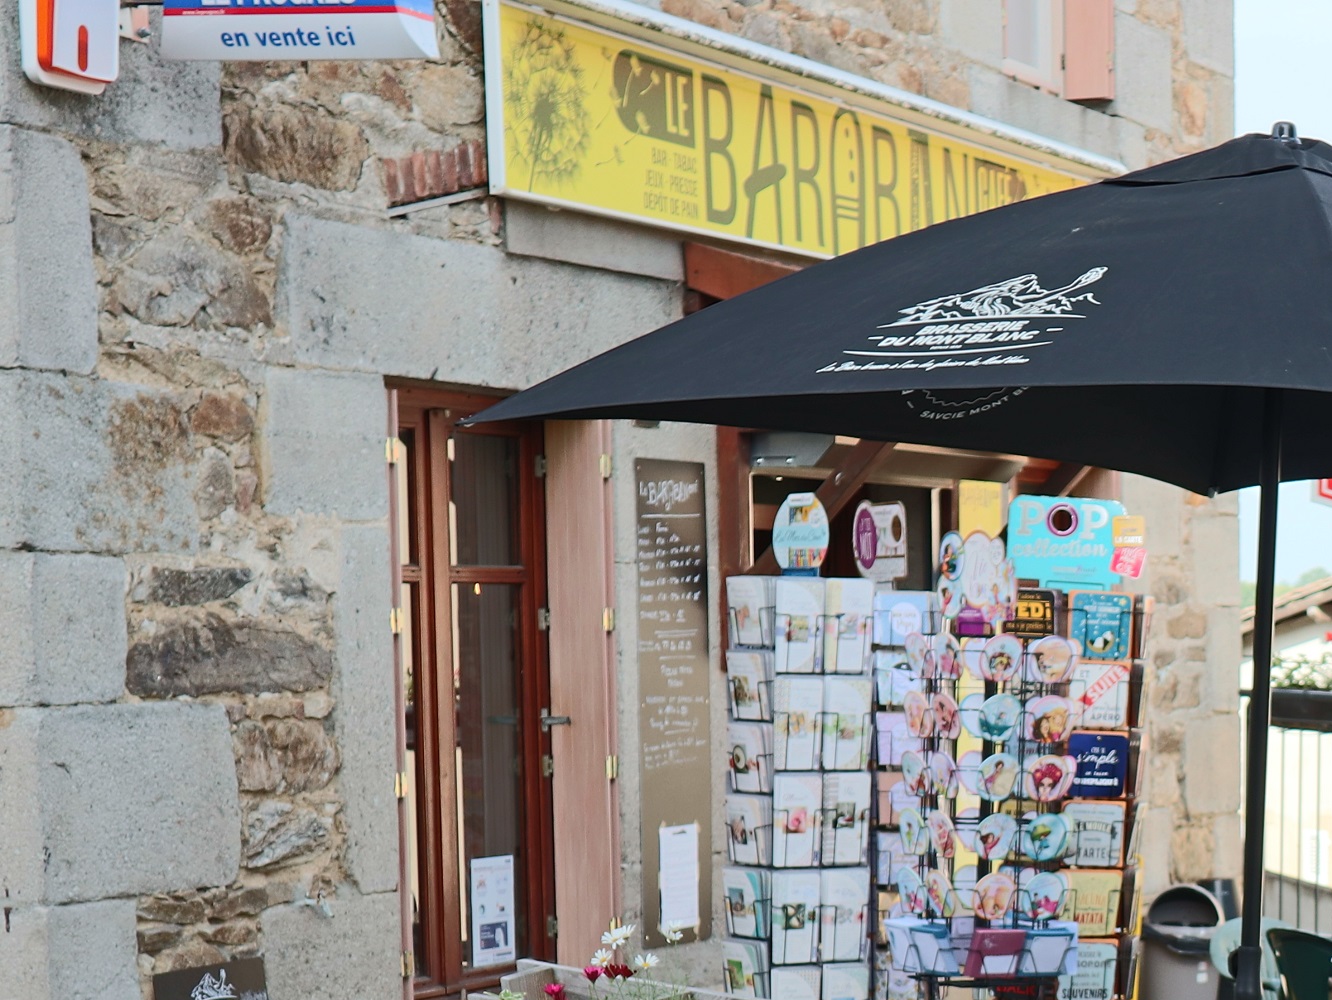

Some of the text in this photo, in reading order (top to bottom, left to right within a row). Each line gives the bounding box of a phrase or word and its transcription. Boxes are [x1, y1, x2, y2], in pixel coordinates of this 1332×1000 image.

[221, 26, 356, 47] en vente ici
[664, 72, 690, 137] LE
[652, 147, 698, 174] BAR TABAC
[645, 169, 699, 198] JEUX PRESSE
[643, 191, 699, 220] DÉPÔT DE PAIN
[877, 330, 1040, 347] DU MONT BLANC
[916, 320, 1030, 336] BRASSERIE
[1017, 500, 1109, 540] POP
[1012, 538, 1108, 558] collection
[1062, 988, 1108, 999] SOUVENIRS
